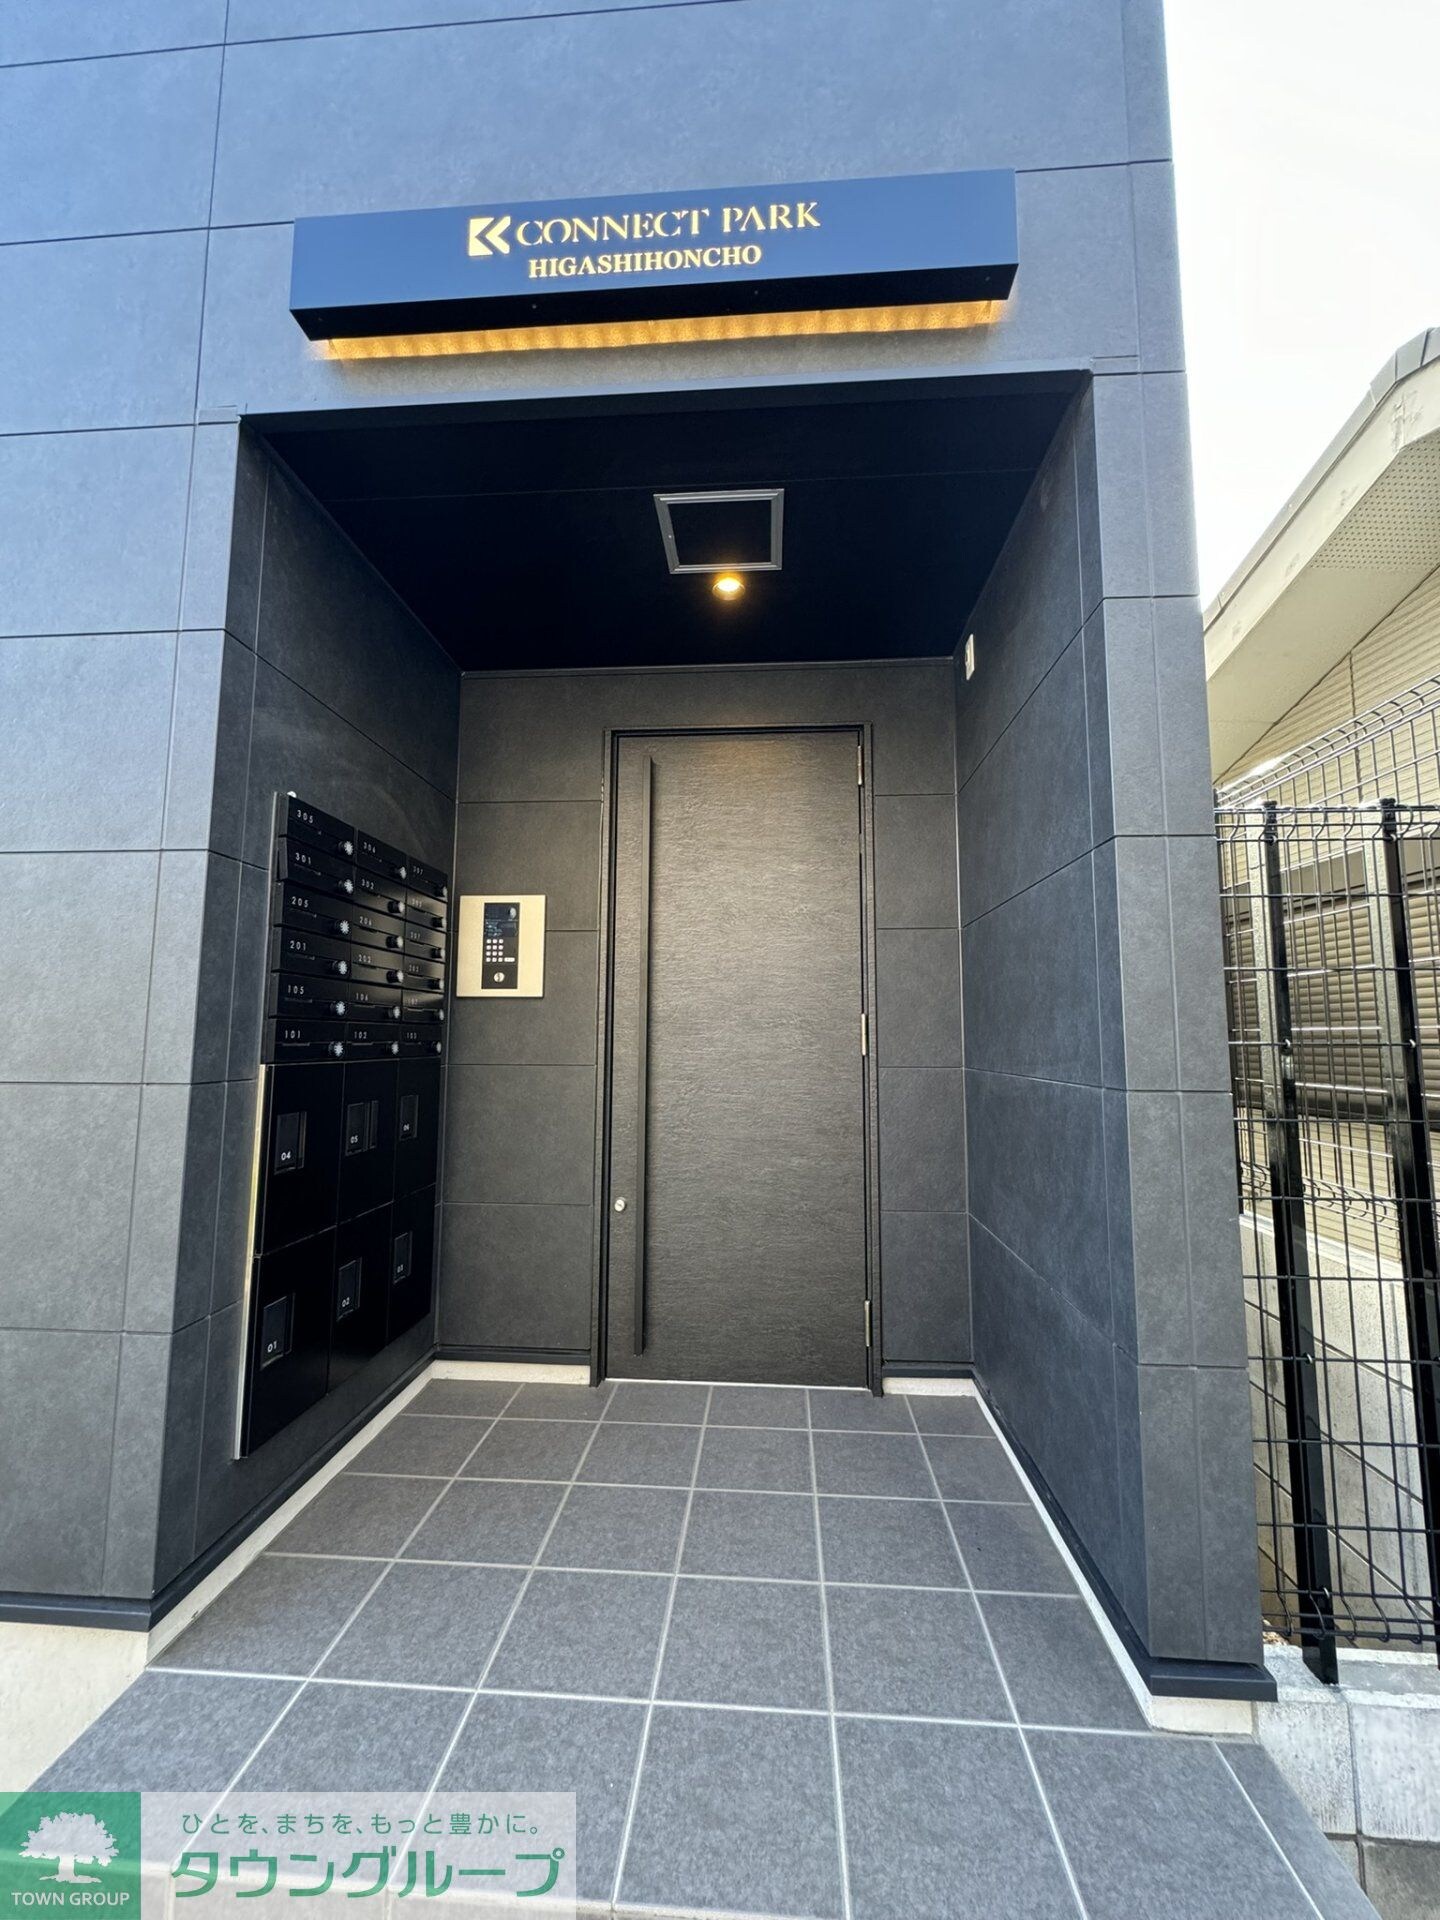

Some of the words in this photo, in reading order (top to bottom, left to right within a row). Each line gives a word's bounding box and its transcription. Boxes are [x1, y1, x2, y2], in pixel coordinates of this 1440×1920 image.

[516, 207, 710, 246] CONNECT
[722, 201, 821, 233] PARK
[528, 244, 762, 279] HIGASHIHONCHO
[297, 809, 314, 824] 305
[295, 852, 312, 865] 301
[291, 896, 309, 908] 205
[289, 940, 306, 951] 201
[287, 984, 305, 995] 105
[284, 1030, 301, 1039] 101
[280, 1151, 291, 1161] 04
[267, 1340, 277, 1353] 01
